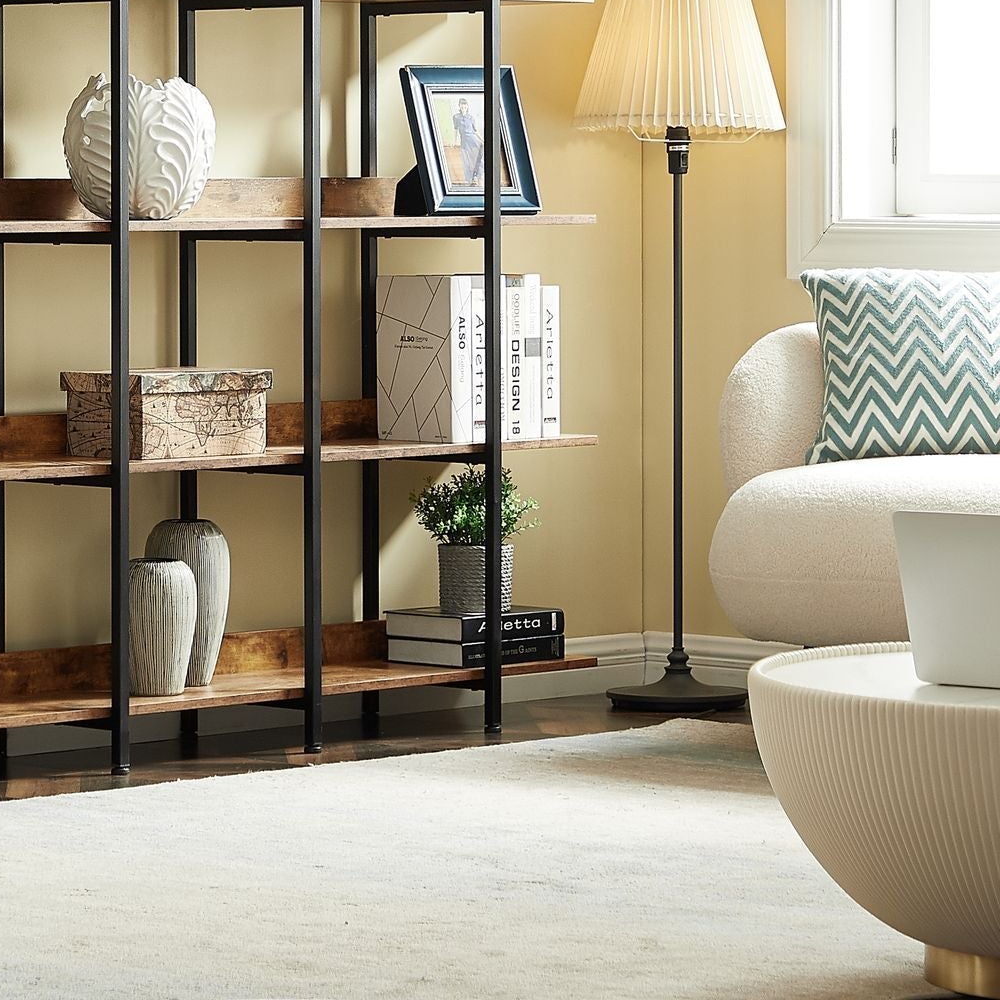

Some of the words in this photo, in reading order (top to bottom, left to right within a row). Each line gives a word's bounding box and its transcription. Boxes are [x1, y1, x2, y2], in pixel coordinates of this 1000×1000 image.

[458, 316, 466, 350] ALSO
[475, 314, 486, 406] Arletta
[546, 309, 554, 399] Arletta
[511, 340, 520, 411] DESIGN
[512, 420, 520, 435] 18
